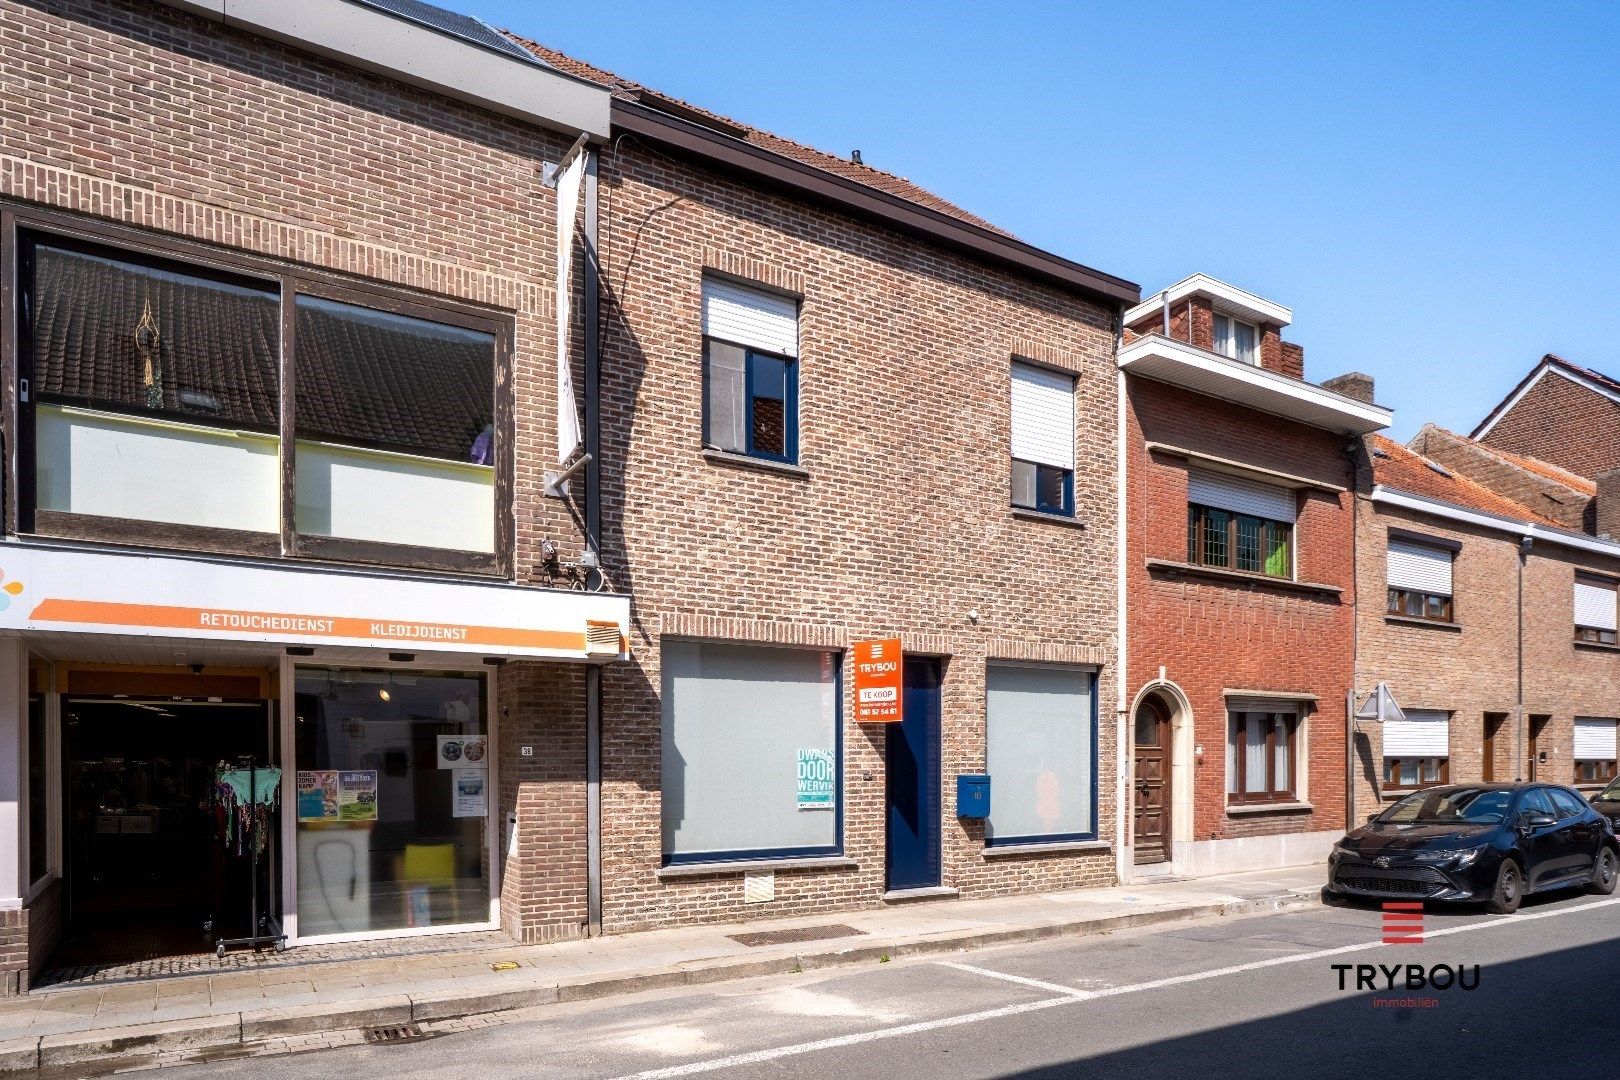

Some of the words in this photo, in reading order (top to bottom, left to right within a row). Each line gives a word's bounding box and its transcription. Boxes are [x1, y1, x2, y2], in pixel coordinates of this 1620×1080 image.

[200, 612, 335, 633] RETOUCHEDIENST
[371, 623, 468, 640] KLEDIJDIENST
[859, 662, 897, 672] TRYBOU
[874, 690, 892, 698] KOOP
[798, 780, 834, 792] WERVIK
